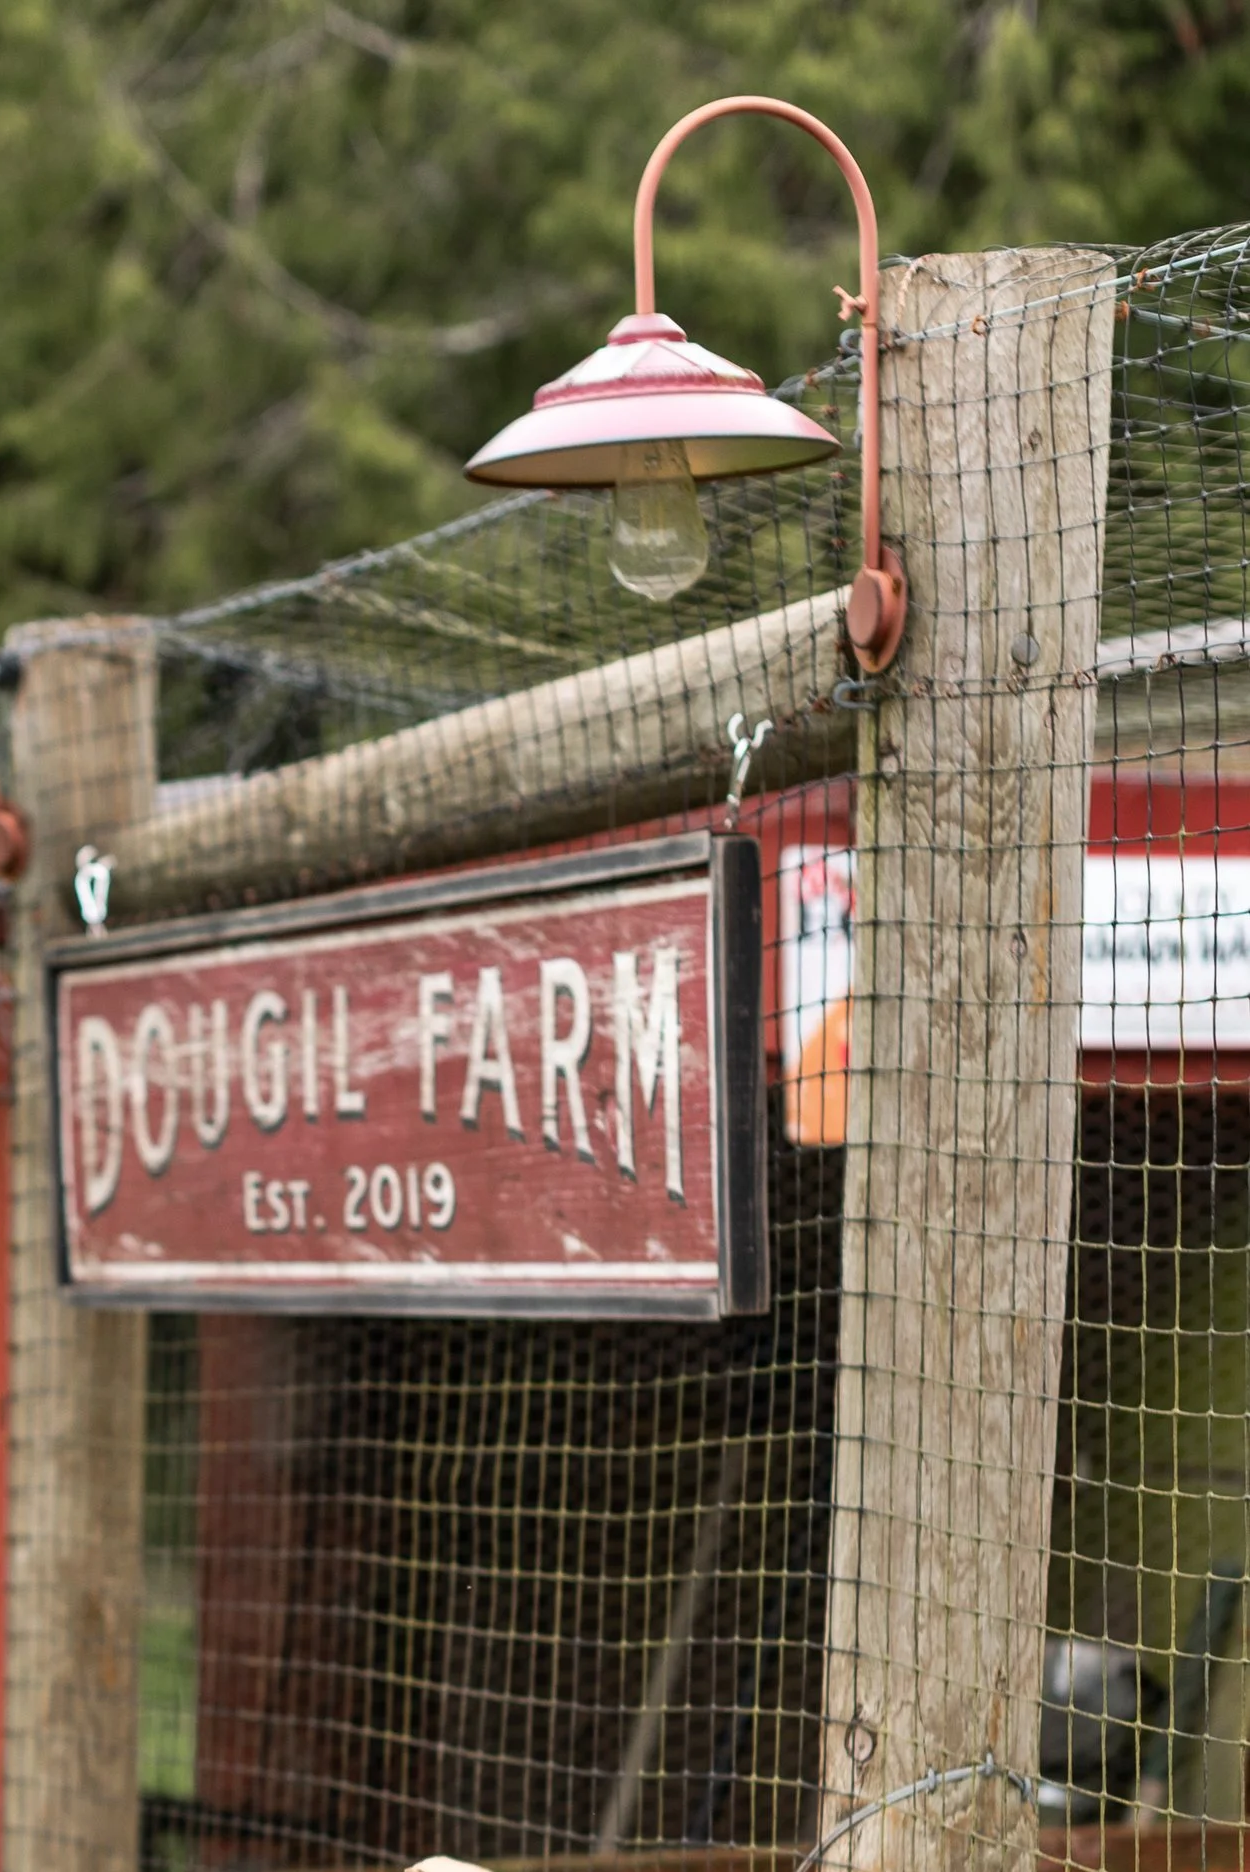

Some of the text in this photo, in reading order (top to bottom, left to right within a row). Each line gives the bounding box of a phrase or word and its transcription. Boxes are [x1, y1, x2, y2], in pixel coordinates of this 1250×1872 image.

[78, 946, 685, 1214] DOUGIL FARM
[345, 1162, 456, 1230] 2019
